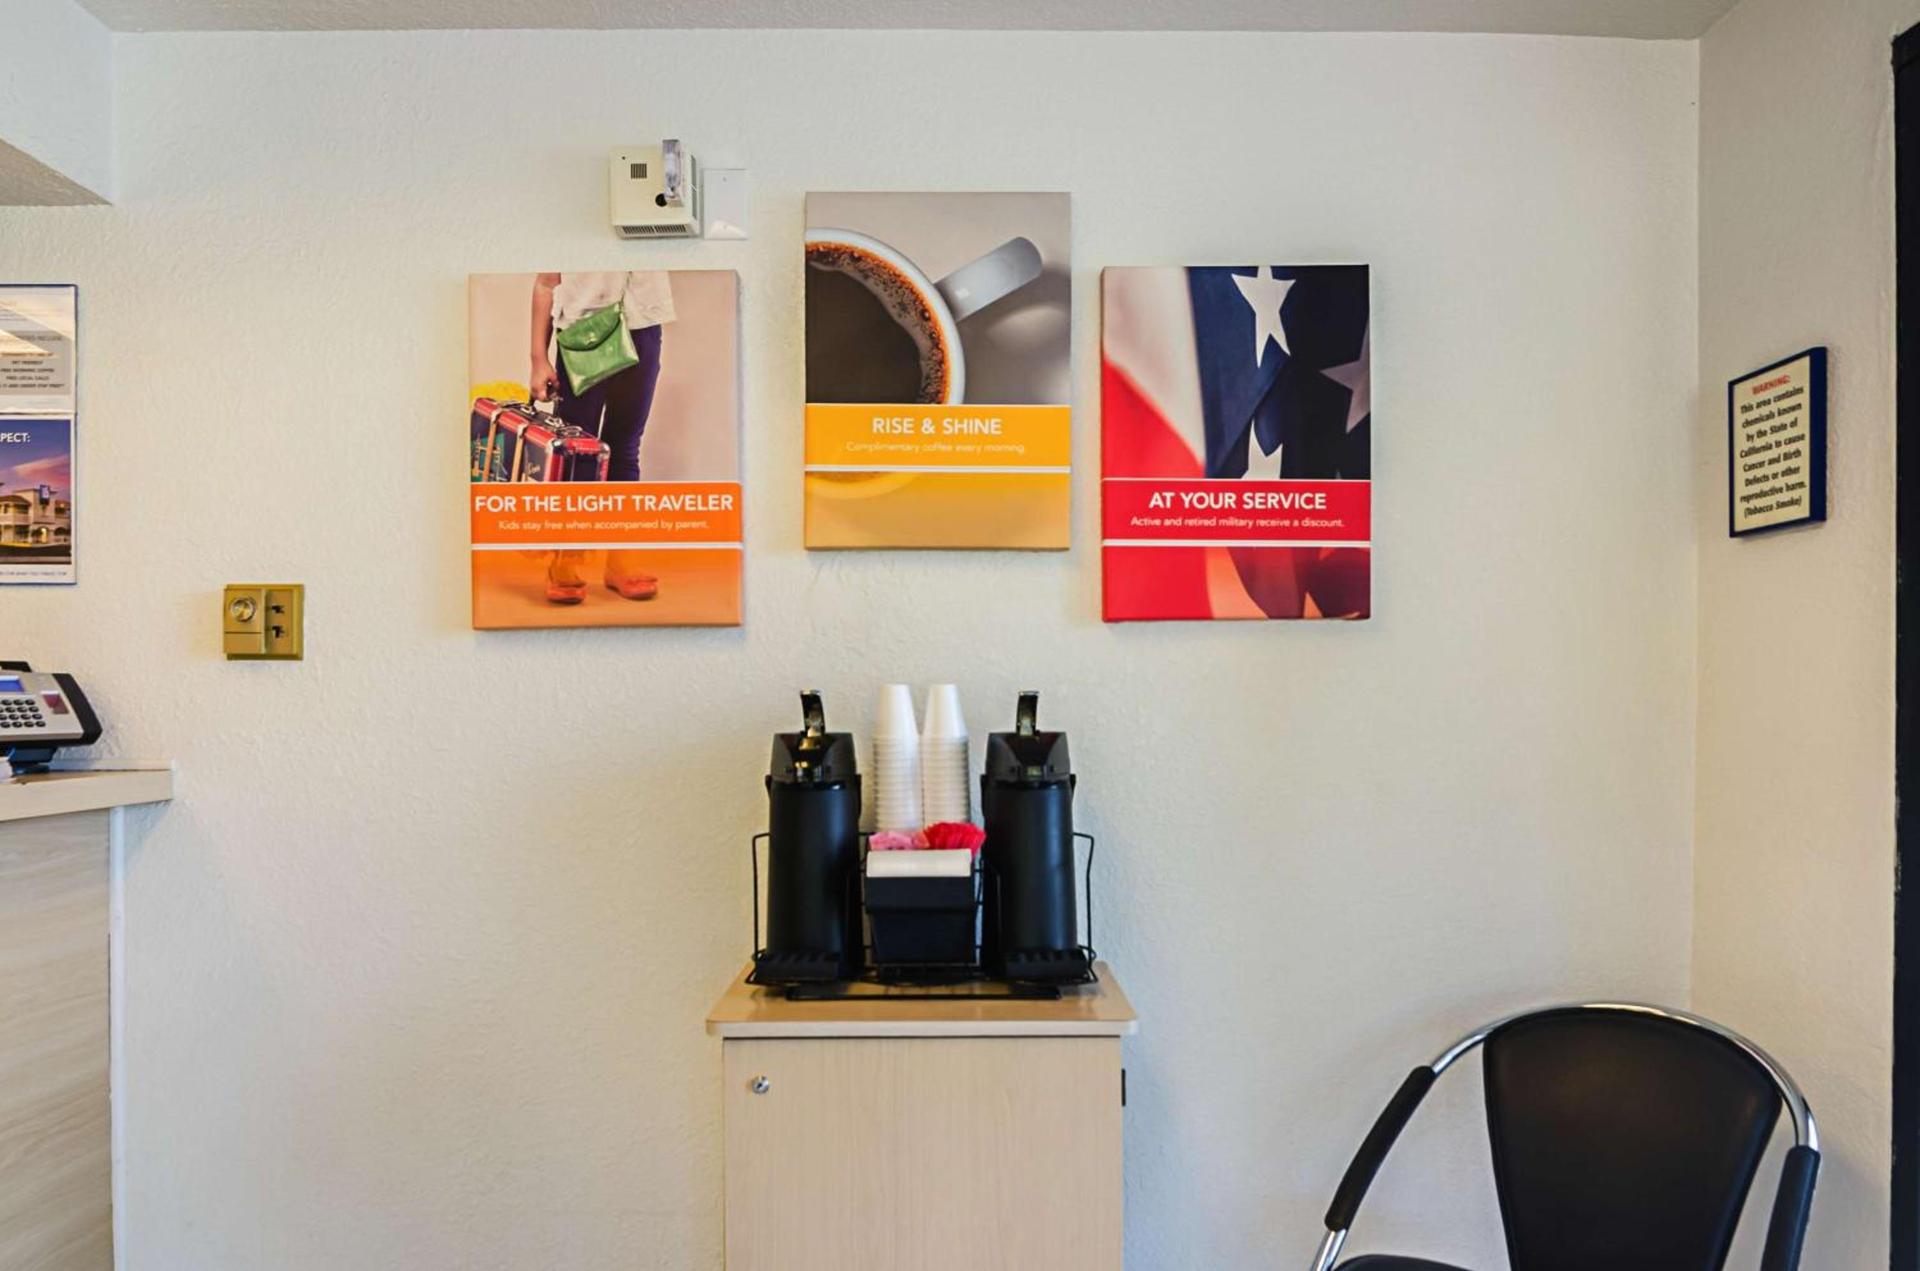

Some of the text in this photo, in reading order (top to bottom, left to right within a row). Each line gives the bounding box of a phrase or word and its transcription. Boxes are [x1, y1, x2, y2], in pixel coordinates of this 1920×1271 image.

[1740, 386, 1804, 414] This area contains
[1742, 402, 1802, 428] chemicals known
[872, 417, 1003, 435] RISE & SHINE
[1756, 428, 1768, 439] the
[1770, 422, 1787, 434] State
[1789, 416, 1798, 428] of
[1740, 442, 1773, 458] California
[1784, 433, 1805, 445] cause
[1743, 448, 1801, 472] Cancer and Birth
[1745, 474, 1770, 487] Defects
[1781, 465, 1800, 478] other
[475, 494, 734, 513] FOR THE LIGHT TRAVELER
[1149, 492, 1327, 510] AT YOUR SERVICE
[1740, 485, 1783, 504] reproductive
[498, 520, 520, 530] Kids
[522, 521, 542, 532] stay
[544, 520, 564, 530] free
[565, 520, 593, 530] when
[660, 519, 673, 531] by
[1130, 516, 1162, 527] Active
[1163, 517, 1182, 527] and
[1184, 517, 1217, 527] retired
[1218, 517, 1254, 529] military
[1256, 518, 1291, 527] receive
